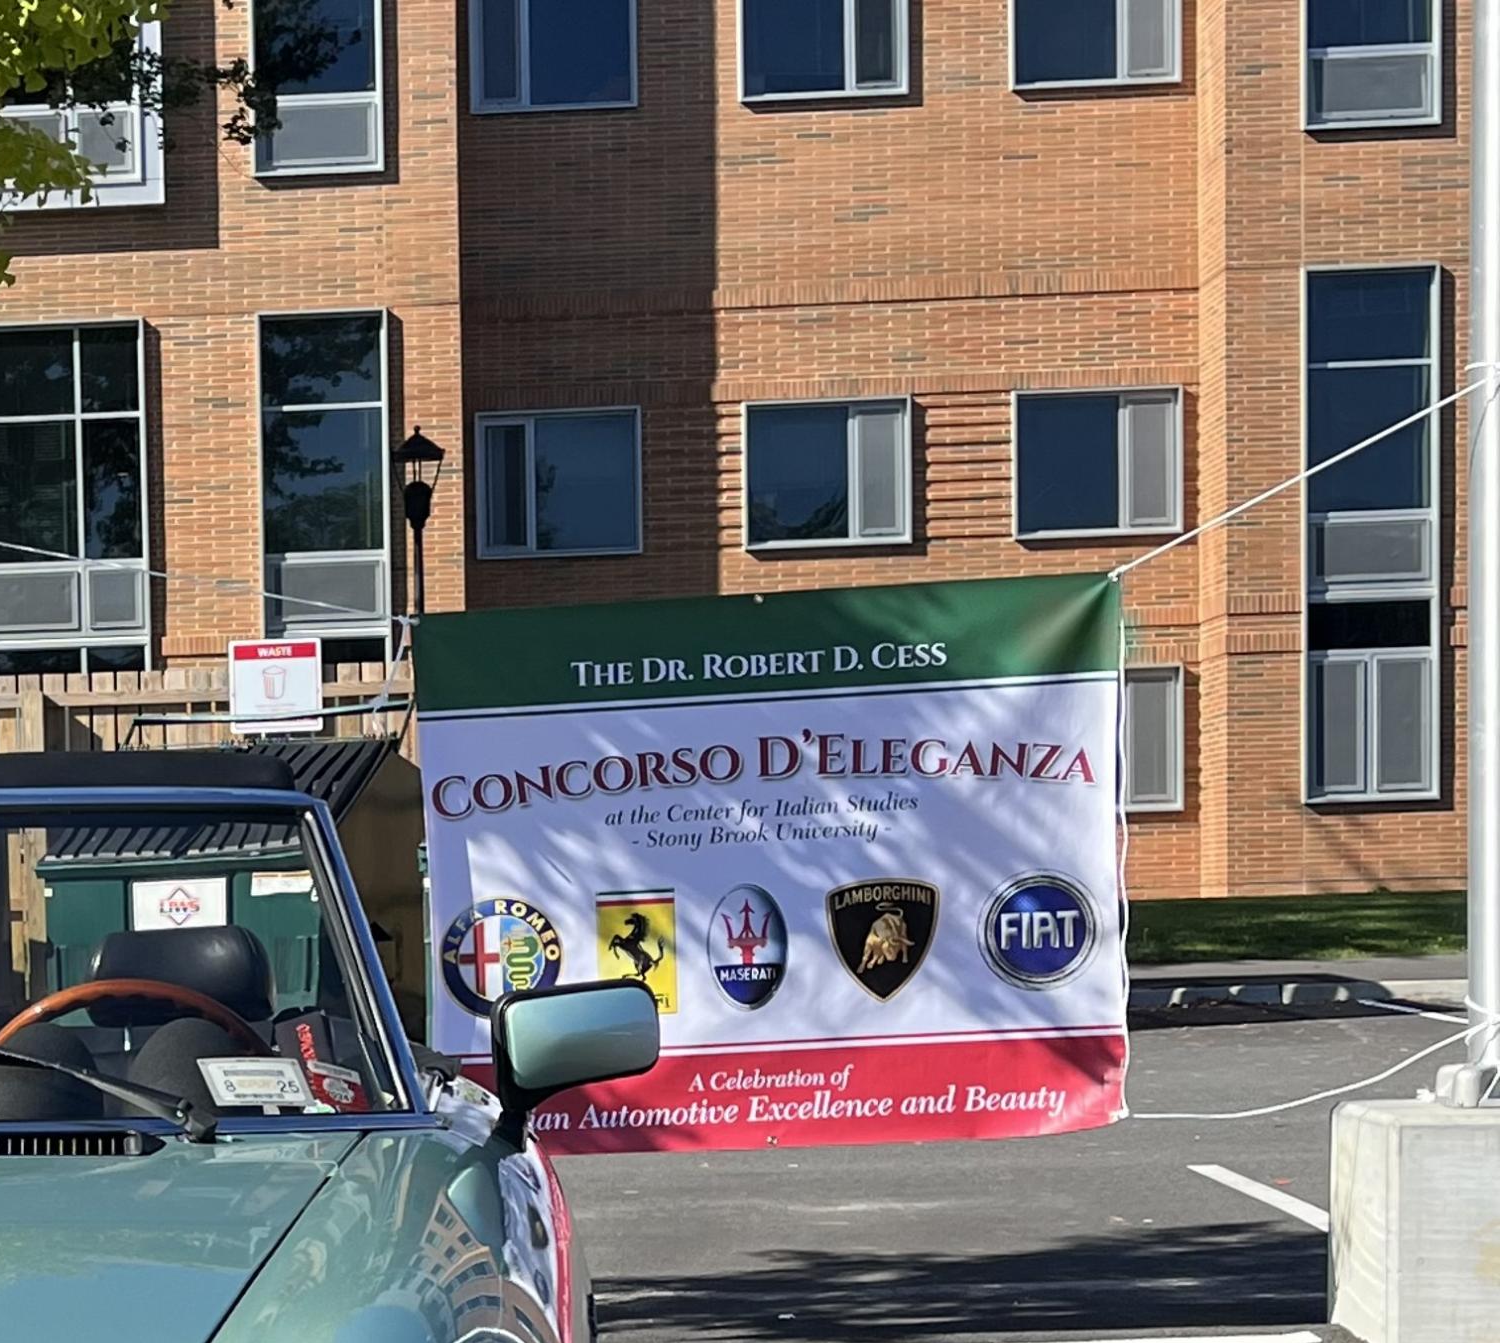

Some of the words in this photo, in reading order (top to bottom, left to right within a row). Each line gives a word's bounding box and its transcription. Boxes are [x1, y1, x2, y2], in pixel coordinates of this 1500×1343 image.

[256, 646, 293, 657] WASTE
[832, 645, 864, 672] D.
[431, 744, 743, 821] CONCORSO
[604, 809, 625, 826] at
[630, 804, 661, 825] the
[666, 803, 735, 823] Center
[735, 799, 770, 826] for
[774, 795, 839, 817] Italian
[846, 790, 920, 813] Studies
[646, 829, 703, 852] Stony
[709, 822, 769, 845] Brook
[776, 819, 879, 843] University
[834, 882, 932, 910] LAMBORGHINI
[443, 908, 484, 964] ALFA
[494, 900, 560, 961] ROMEO
[1000, 909, 1080, 952] FIAT
[720, 967, 777, 982] MASERATI
[687, 1072, 705, 1093] A
[710, 1067, 825, 1091] Celebration
[829, 1064, 855, 1093] of
[577, 1097, 740, 1131] Automotive
[746, 1089, 893, 1124] Excellence
[900, 1084, 957, 1116] and
[964, 1084, 1067, 1117] Beauty
